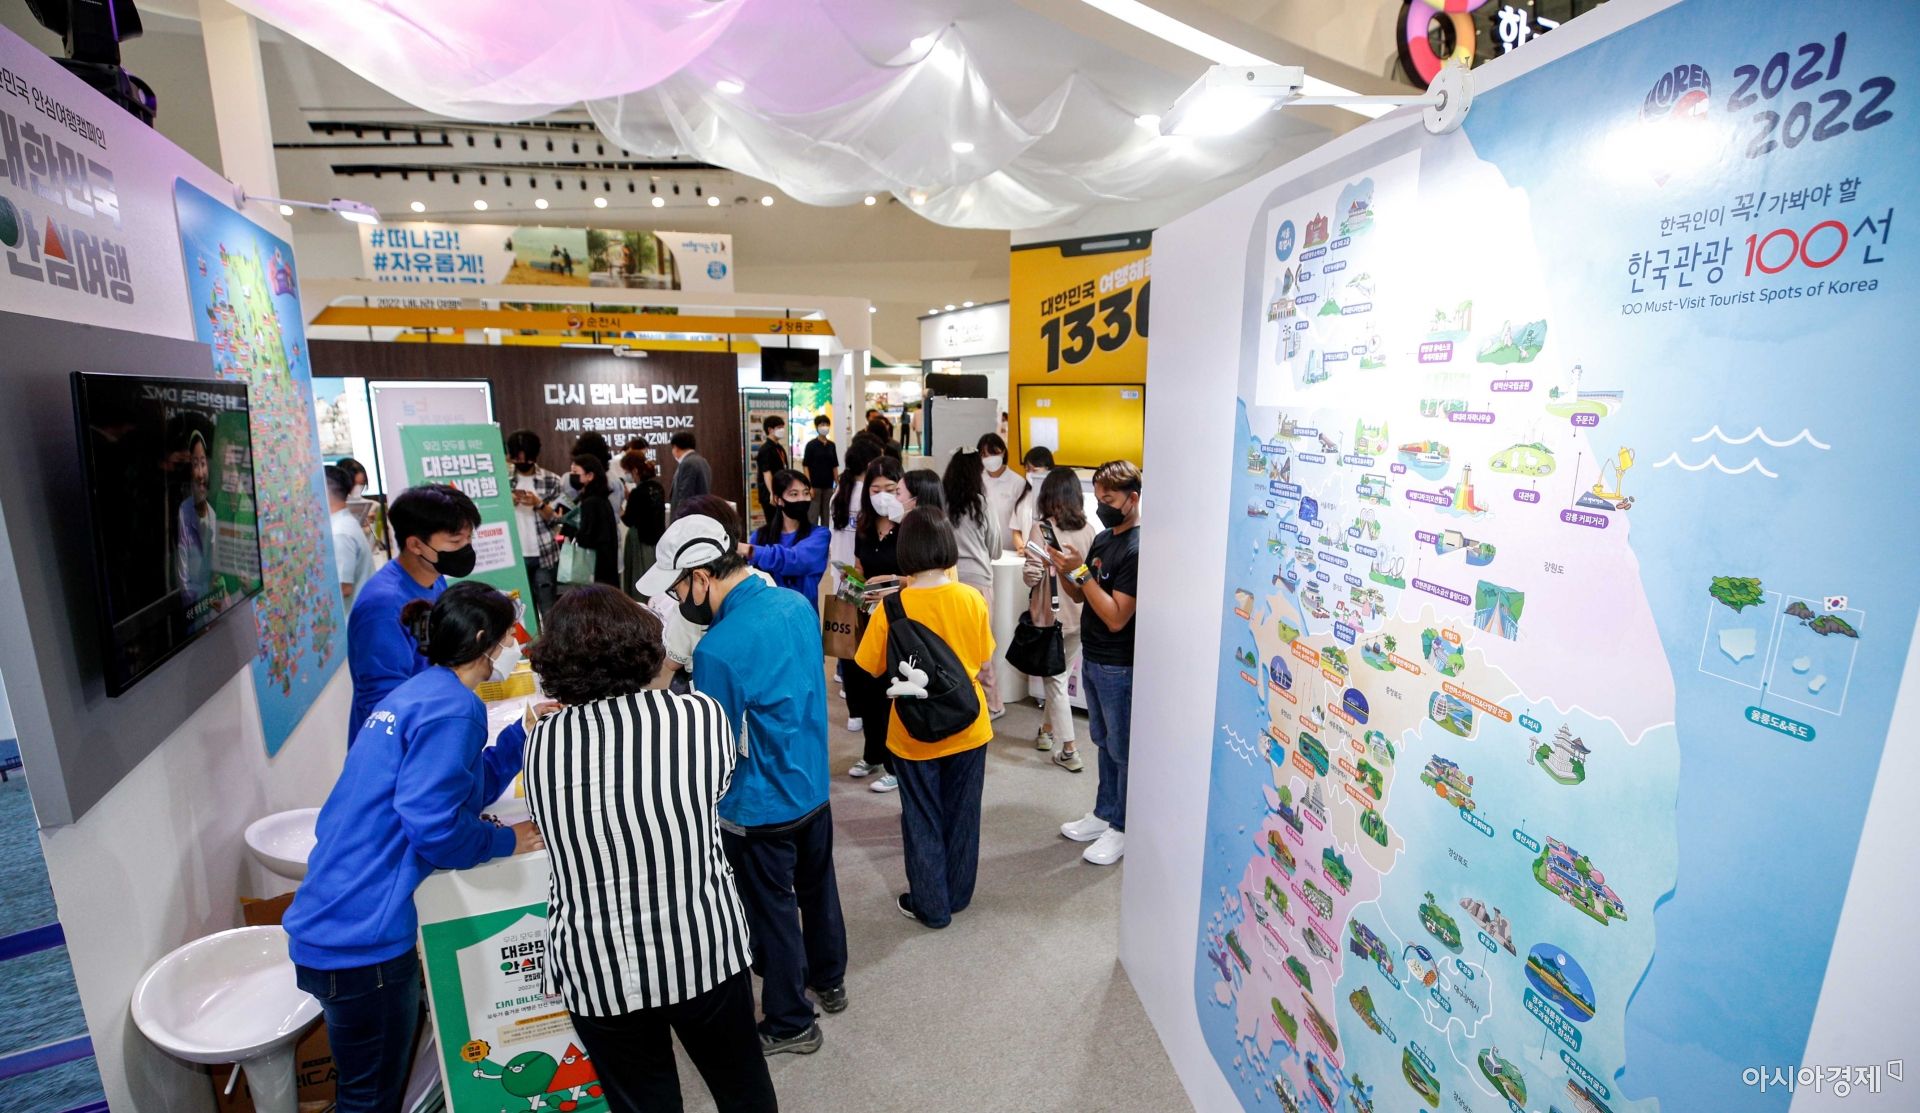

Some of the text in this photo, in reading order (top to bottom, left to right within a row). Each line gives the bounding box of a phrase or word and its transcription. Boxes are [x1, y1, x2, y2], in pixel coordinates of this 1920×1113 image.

[1727, 31, 1847, 113] 2021
[0, 68, 107, 150] 민국 안심여행캠페인
[1745, 76, 1897, 159] 2022
[1660, 178, 1862, 238] 한국인이 꼭! 가봐야 할
[371, 228, 460, 250] #떠나라!
[374, 252, 484, 274] #자유롭게!
[1628, 237, 1733, 293] 한국관광
[1040, 280, 1096, 317] 대한민국
[1621, 276, 1879, 316] 100 Must-Visit Tourist Spots of Korea
[586, 316, 621, 329] 순천시
[544, 383, 699, 405] 다시 만나는 DMZ
[555, 415, 694, 432] 세계 유일의 대한민국 DMZ
[1575, 415, 1595, 425] 주문진
[614, 433, 626, 447] 땅
[421, 453, 496, 479] 대한민국
[1518, 491, 1535, 501] 대관령
[1565, 512, 1605, 527] 강릉 커피거리
[825, 620, 851, 635] BOSS
[1522, 716, 1539, 731] 부석사
[1751, 709, 1809, 738] 울릉도&독도
[1515, 830, 1538, 850] 병산서원
[495, 1000, 514, 1010] 다시
